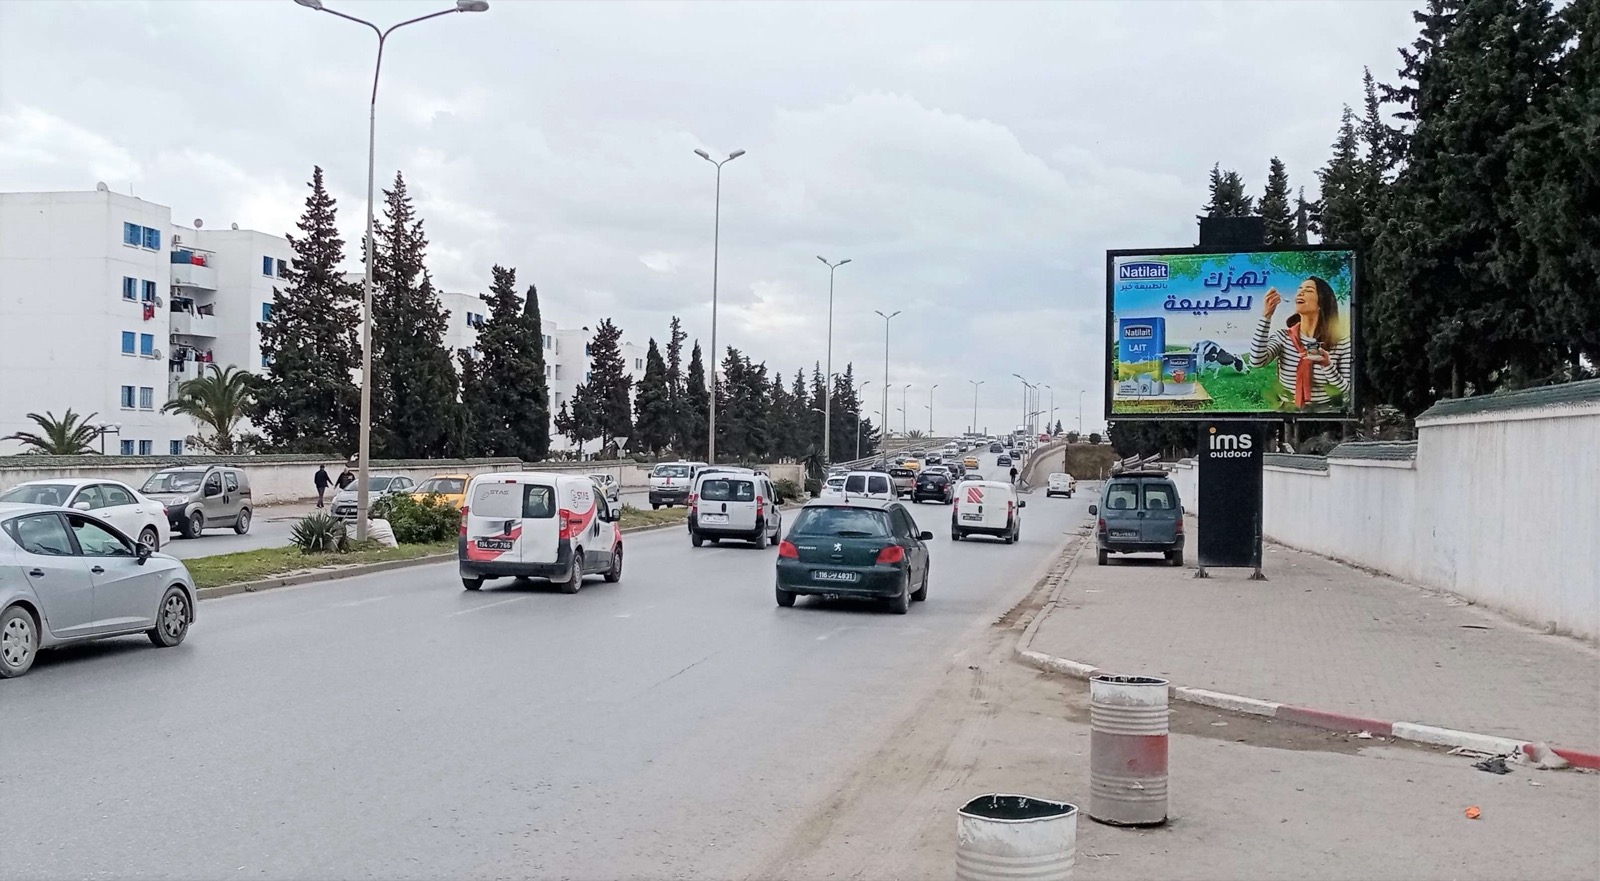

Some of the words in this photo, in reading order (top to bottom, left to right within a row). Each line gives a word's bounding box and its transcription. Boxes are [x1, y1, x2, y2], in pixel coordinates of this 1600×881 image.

[1121, 265, 1167, 278] Natilait
[1163, 294, 1254, 315] للطبيعة
[1124, 328, 1152, 337] Natilait
[1128, 344, 1147, 352] LAIT
[1209, 426, 1252, 450] ims
[1210, 450, 1253, 458] outdoor
